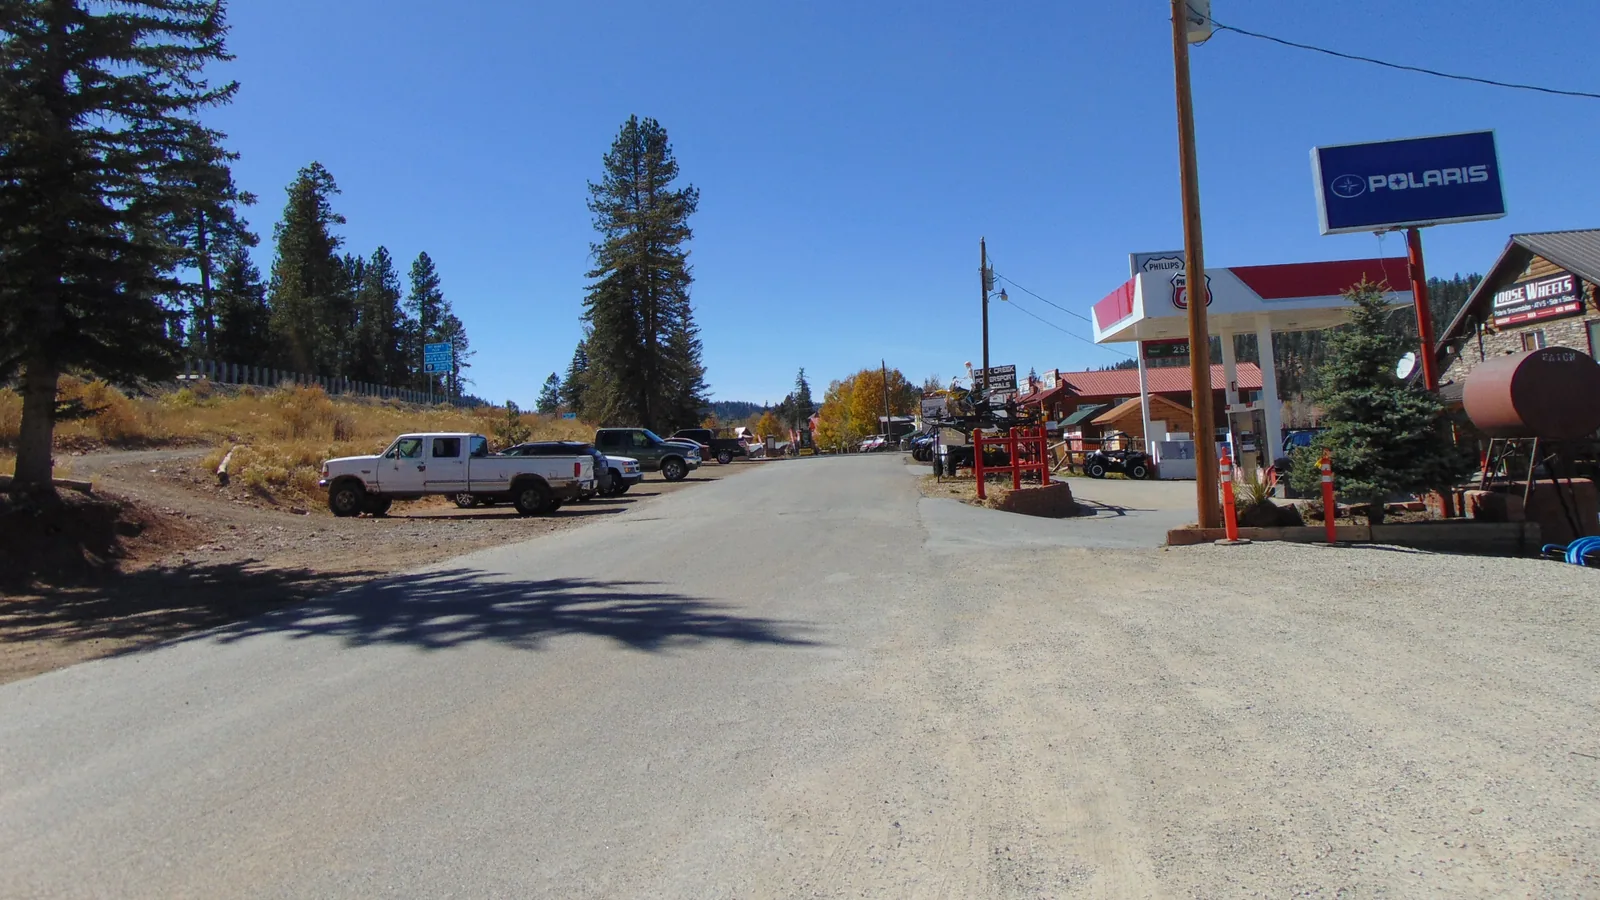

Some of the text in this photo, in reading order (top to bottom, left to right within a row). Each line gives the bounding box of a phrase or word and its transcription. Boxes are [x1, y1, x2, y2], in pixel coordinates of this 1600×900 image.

[1368, 165, 1489, 192] POLARIS
[1149, 261, 1180, 271] PHILLIPS
[1494, 279, 1572, 307] LOOSE WHEELS
[975, 373, 1015, 384] POERSPORT
